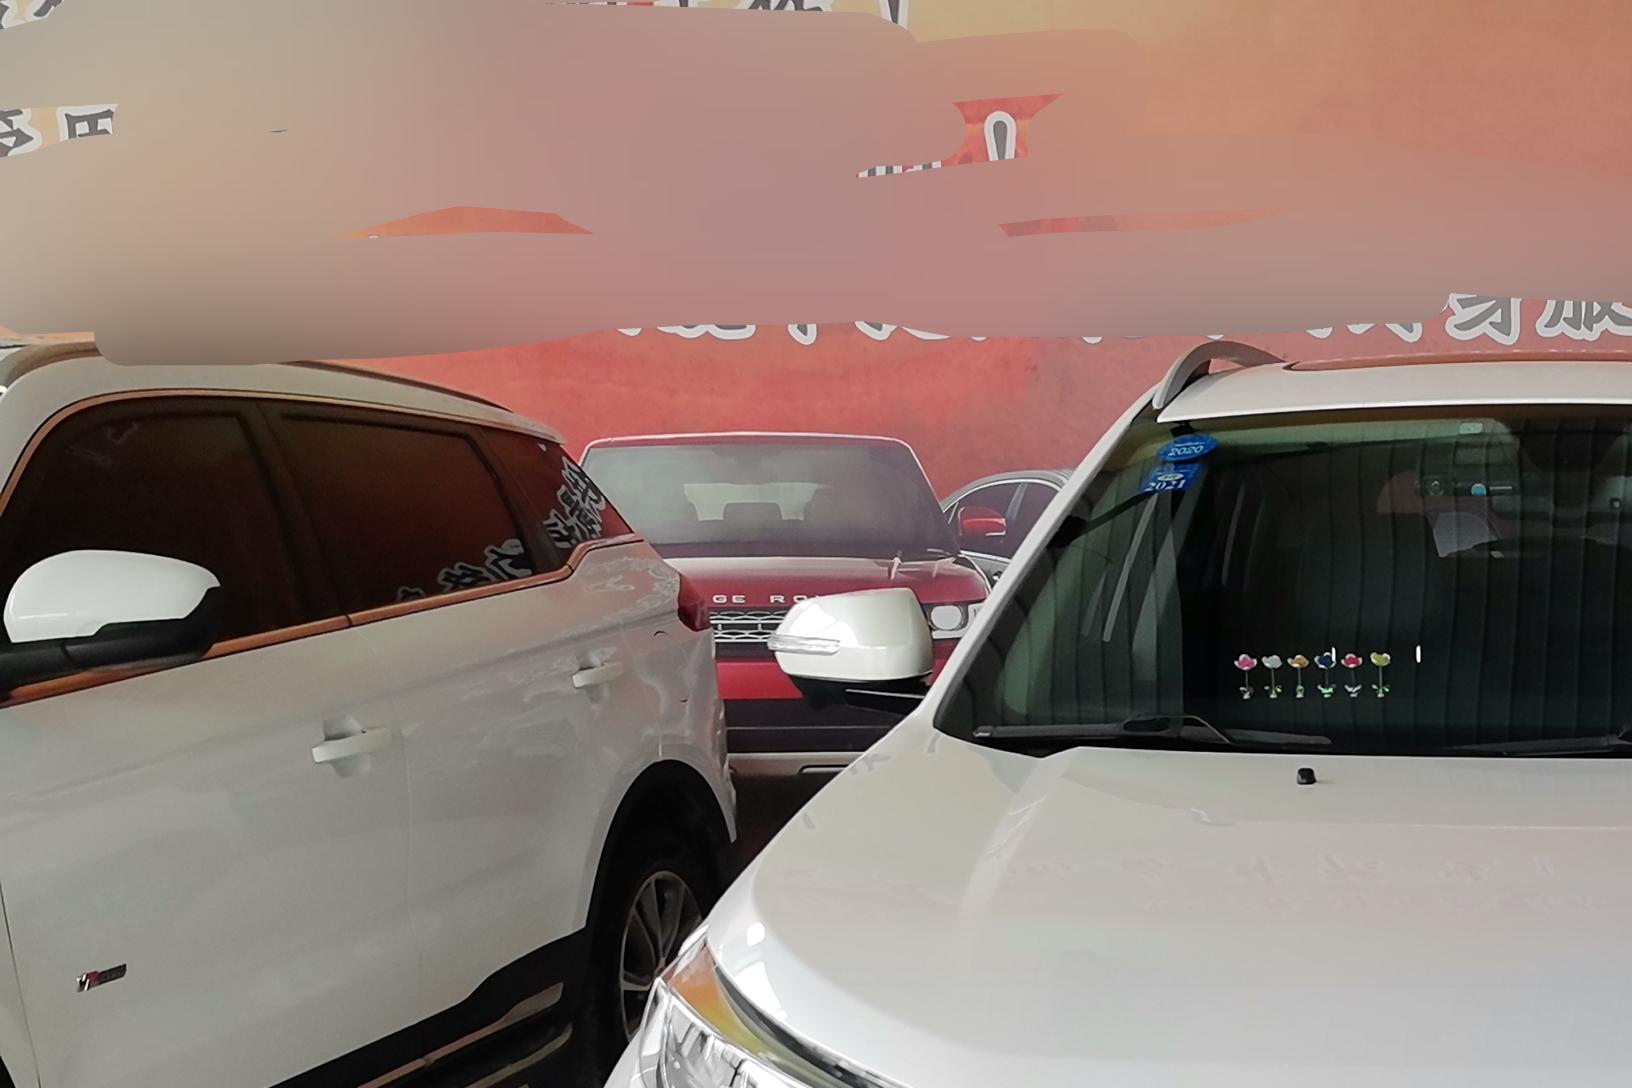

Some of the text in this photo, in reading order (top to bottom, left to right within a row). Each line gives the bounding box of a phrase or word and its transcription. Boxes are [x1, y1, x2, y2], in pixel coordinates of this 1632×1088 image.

[1168, 445, 1205, 457] 2020
[1145, 480, 1187, 491] 2021
[769, 594, 809, 604] RO
